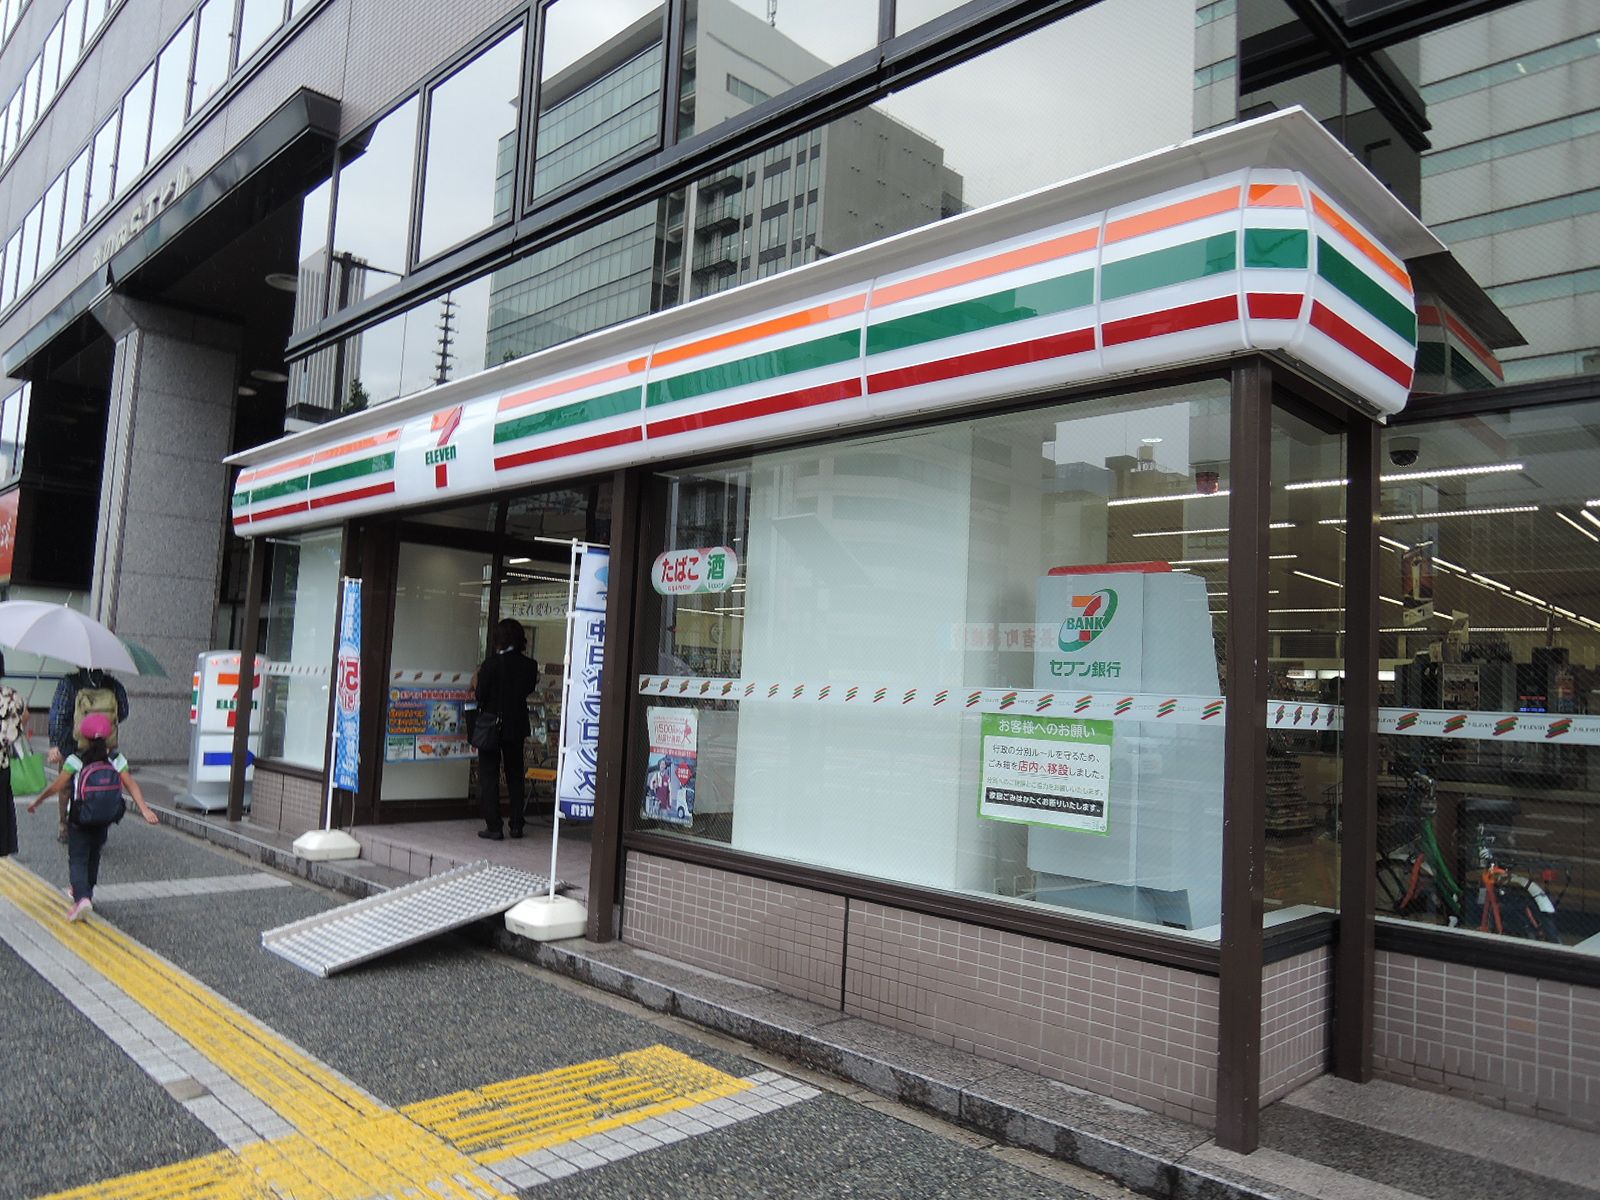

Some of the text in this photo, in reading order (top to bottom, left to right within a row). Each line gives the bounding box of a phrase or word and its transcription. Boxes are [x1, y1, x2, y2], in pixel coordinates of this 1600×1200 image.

[431, 404, 463, 488] 7
[661, 553, 726, 583] たばこ 酒
[1066, 616, 1104, 630] BANK
[1071, 595, 1102, 642] 7
[1049, 659, 1122, 678] セブン銀行
[999, 719, 1096, 738] お客様へのお願い
[992, 743, 1101, 763] 行政の分別ルールを守るため、
[988, 759, 1105, 780] ごみ箱を店内へ移設しました。
